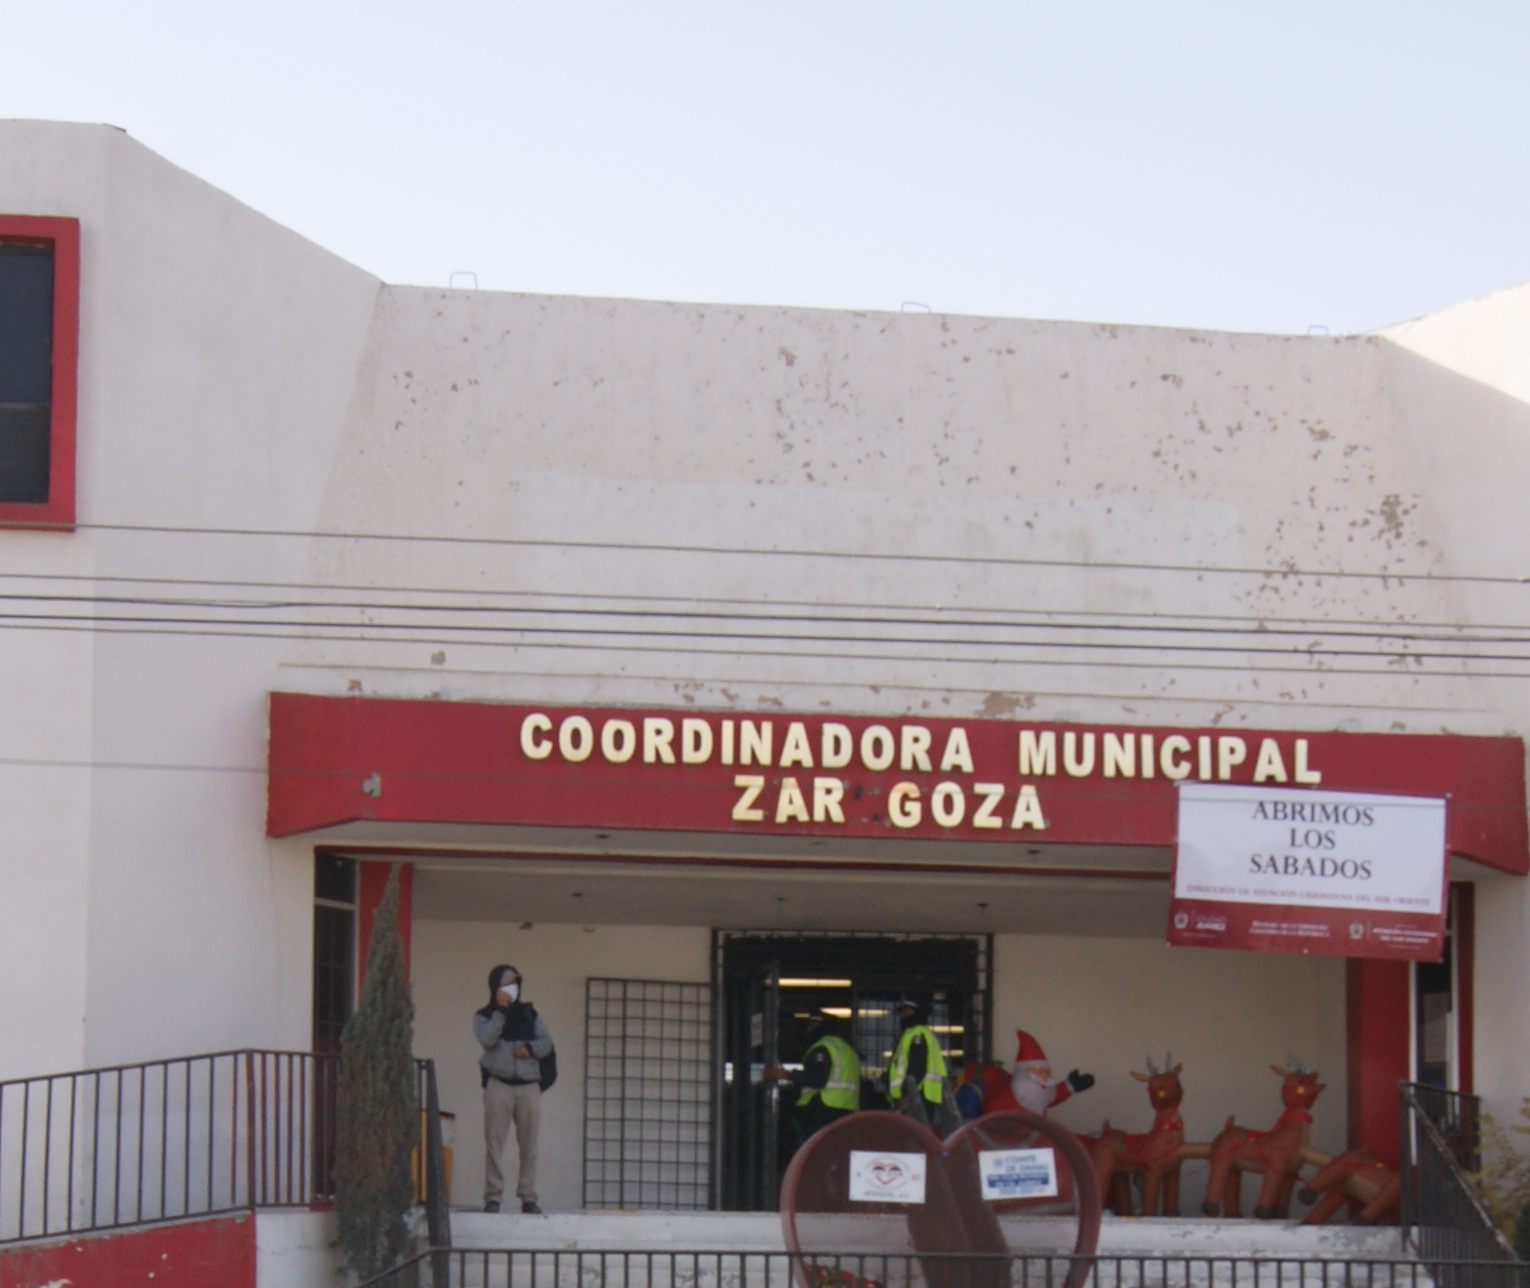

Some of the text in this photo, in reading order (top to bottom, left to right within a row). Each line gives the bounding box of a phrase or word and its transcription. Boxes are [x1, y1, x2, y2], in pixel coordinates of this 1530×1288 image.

[520, 713, 1322, 784] COORDINADORA MUNICIPAL
[732, 774, 1046, 830] ZAR GOZA
[1252, 801, 1375, 827] ABRIMOS
[1289, 828, 1336, 850] LOS
[1249, 854, 1372, 880] SABADOS
